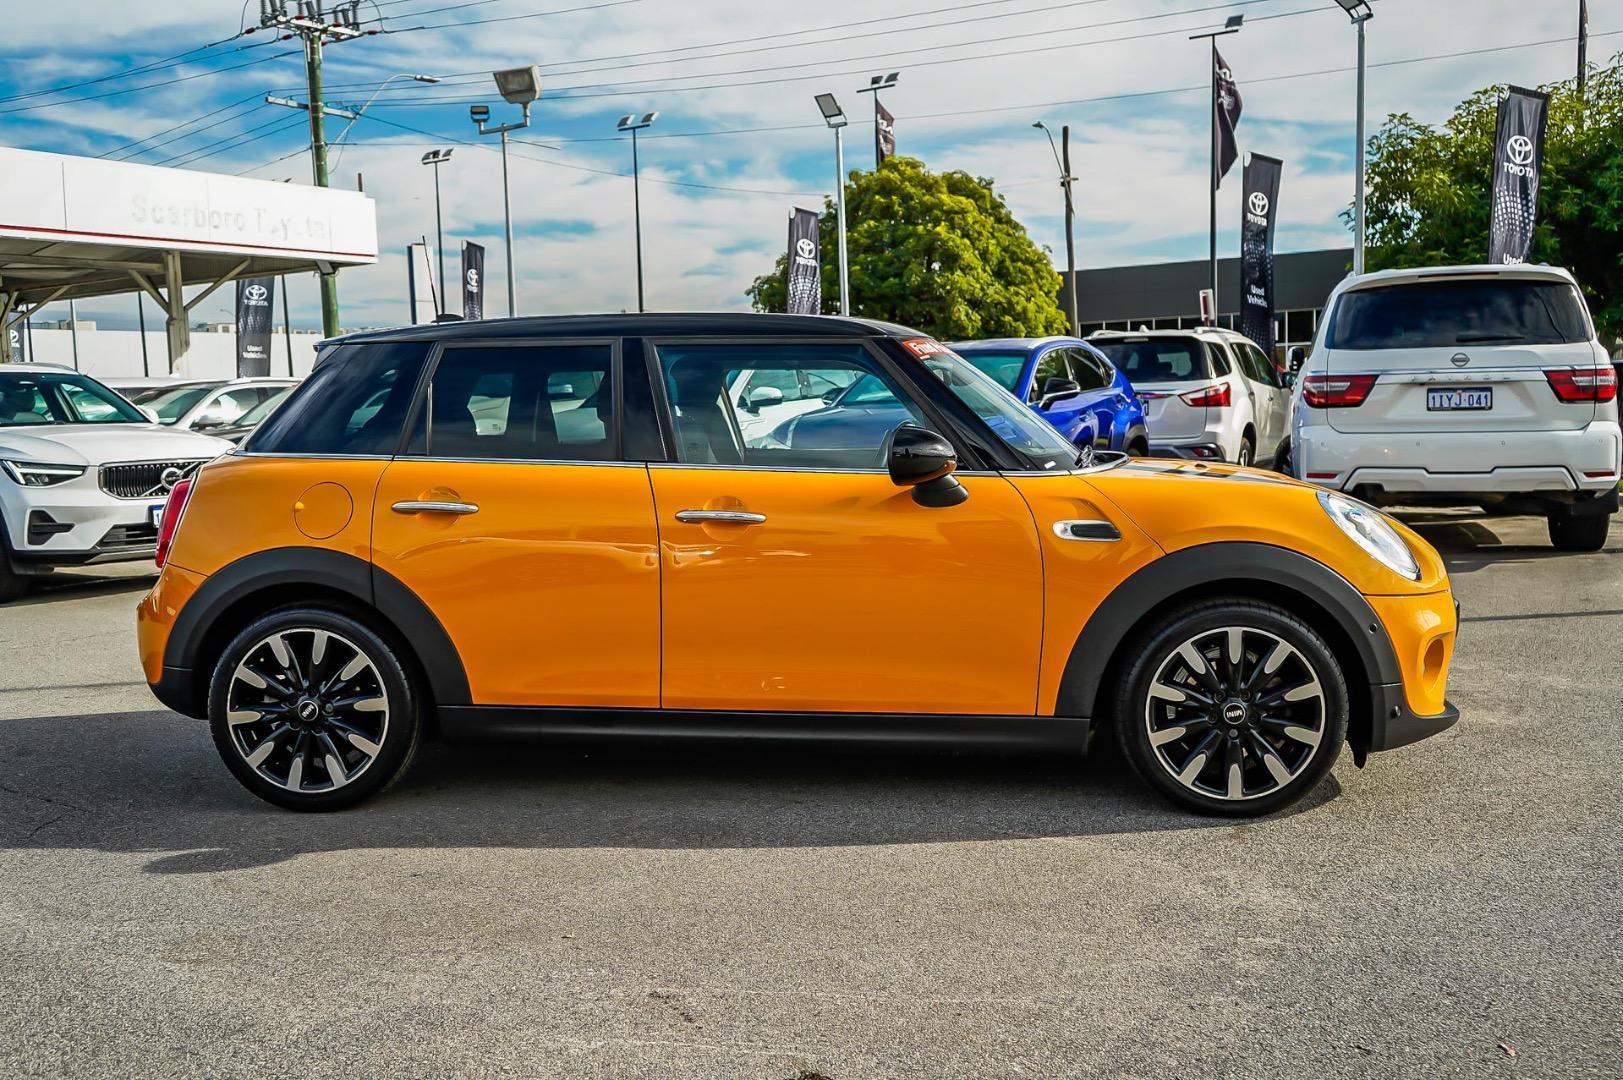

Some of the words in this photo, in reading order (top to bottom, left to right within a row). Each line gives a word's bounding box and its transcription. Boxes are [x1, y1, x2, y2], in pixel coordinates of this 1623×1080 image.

[1503, 161, 1534, 178] TOYOTA
[131, 193, 245, 232] Scarboro
[253, 207, 325, 241] Tyta
[1247, 212, 1267, 226] TOYOTA
[1504, 252, 1523, 264] Used
[1250, 284, 1264, 296] Used
[244, 299, 269, 307] TOYOTA
[246, 344, 263, 352] Used
